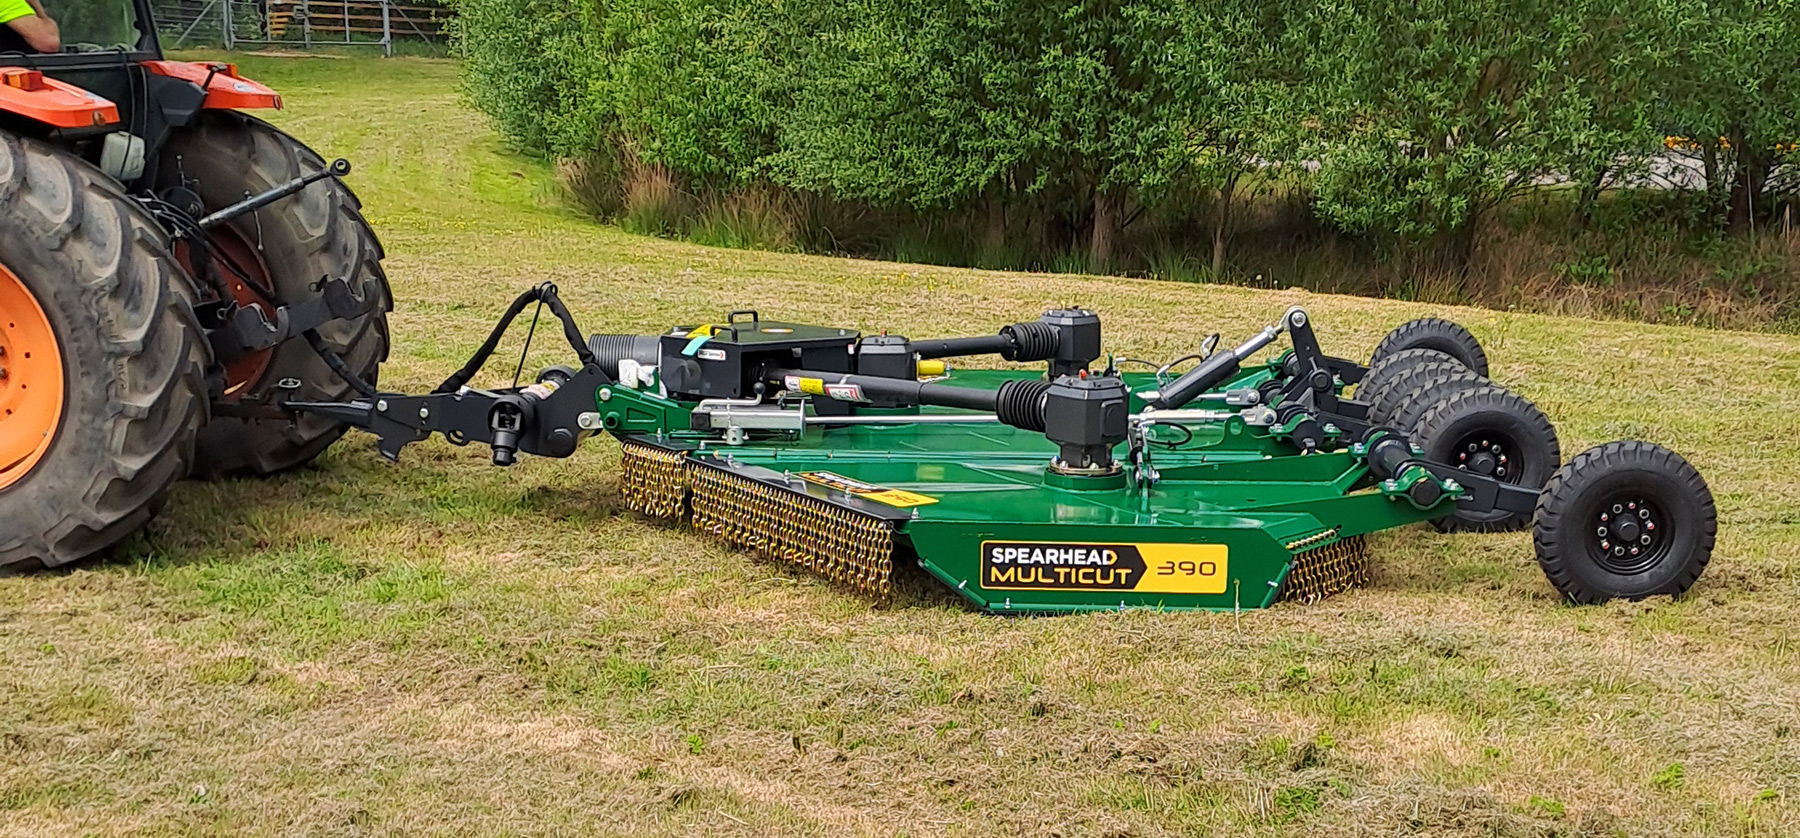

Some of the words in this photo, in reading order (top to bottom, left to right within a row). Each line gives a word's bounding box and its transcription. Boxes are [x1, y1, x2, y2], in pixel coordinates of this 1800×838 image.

[991, 548, 1118, 566] SPEARHEAD
[990, 566, 1133, 585] MULTICUT
[1157, 561, 1217, 577] 390
